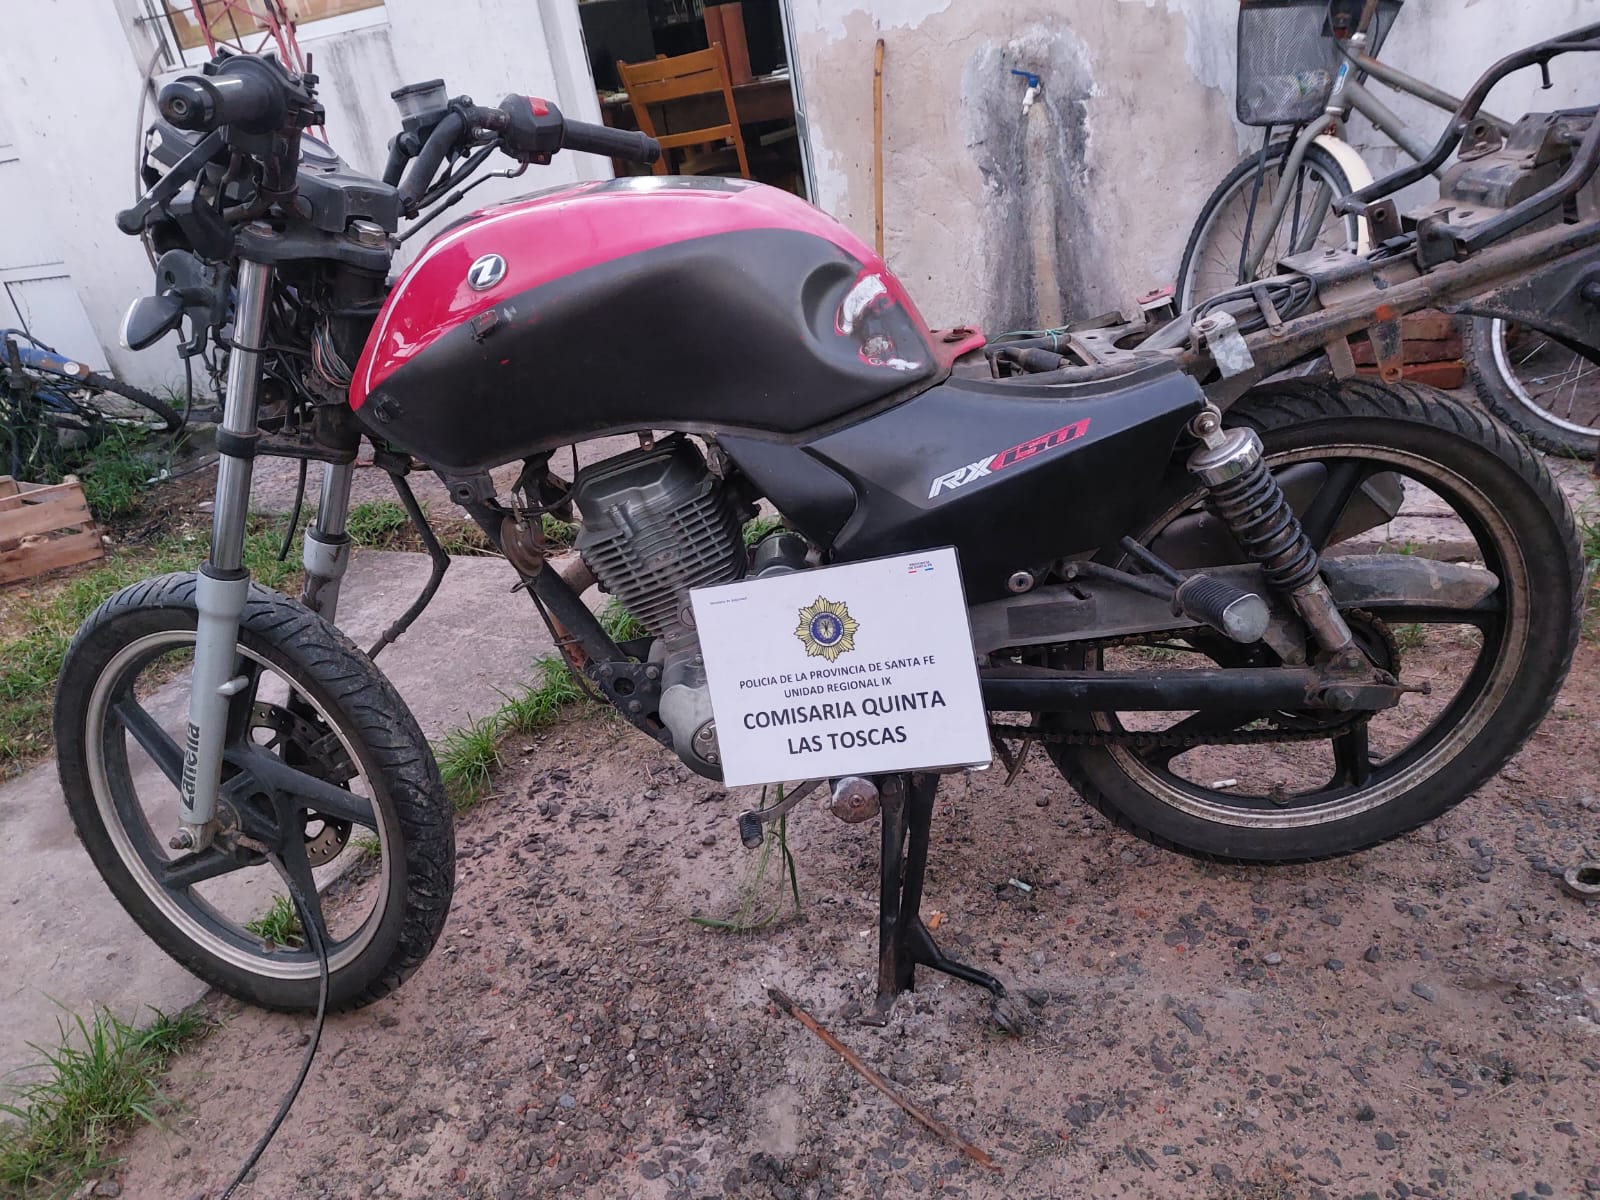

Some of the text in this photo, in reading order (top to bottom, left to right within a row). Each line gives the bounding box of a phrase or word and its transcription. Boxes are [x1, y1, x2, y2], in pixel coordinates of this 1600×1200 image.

[739, 655, 936, 690] POLICIA DE LA PROVINCIA DE SANTA FE
[784, 676, 892, 698] UNIDAD REGIONAL IX
[743, 690, 946, 729] COMISARIA QUINTA
[787, 725, 907, 755] LAS TOSCAS
[181, 721, 200, 811] Zanella
